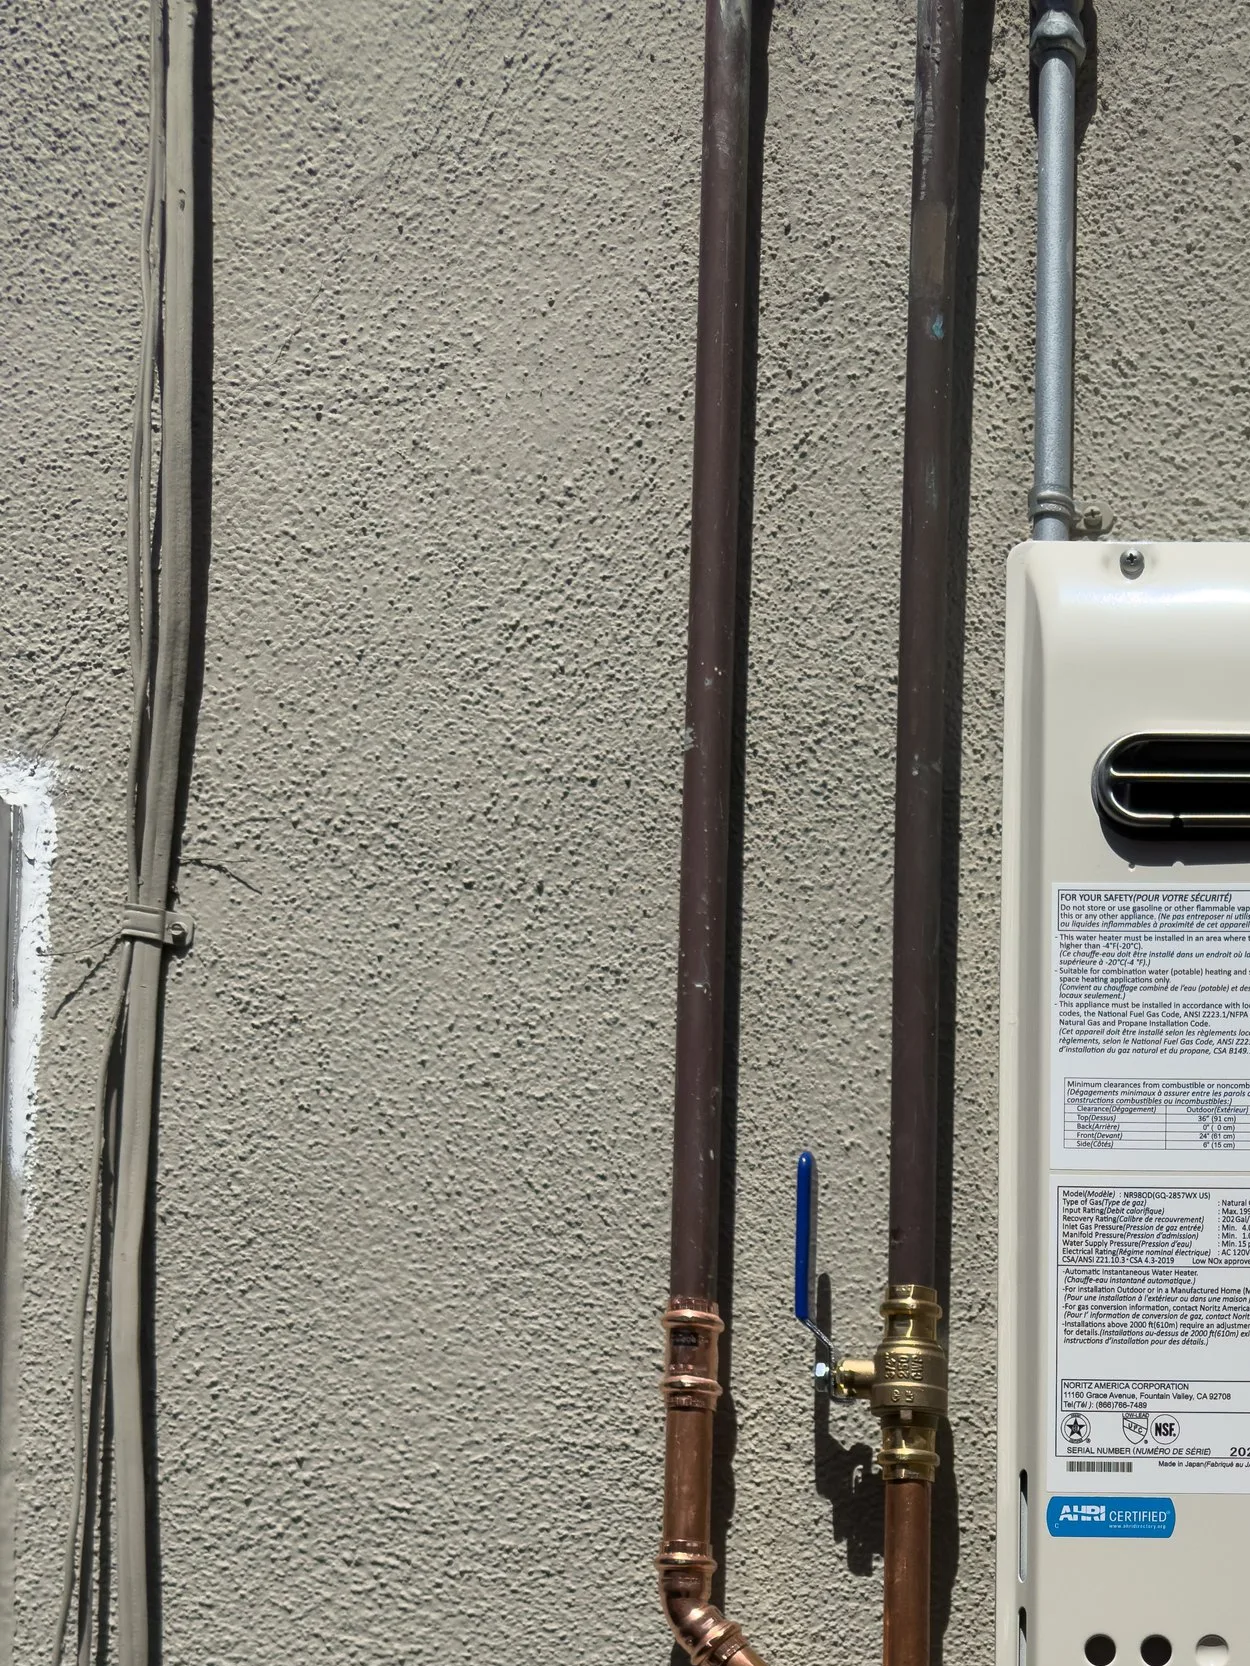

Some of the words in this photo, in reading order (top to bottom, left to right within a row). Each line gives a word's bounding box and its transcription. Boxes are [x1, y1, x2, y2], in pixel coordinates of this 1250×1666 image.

[1060, 893, 1076, 901] FOR
[1078, 893, 1101, 901] YOUR
[1103, 893, 1159, 903] SAFETY(POUR
[1161, 893, 1189, 902] VOTRE
[1190, 892, 1232, 903] SÉCURITÉ)
[1059, 941, 1082, 950] higher
[1117, 1019, 1147, 1027] Propane
[1149, 1019, 1188, 1027] Installation
[1189, 1019, 1210, 1027] Code.
[1103, 1080, 1140, 1088] clearances
[1161, 1081, 1205, 1089] combustible
[1075, 1105, 1158, 1114] Clearance(Dégagement)
[1186, 1105, 1250, 1115] Outdoor(Extérieur)
[1075, 1113, 1116, 1123] Top(Dessus)
[1211, 1115, 1222, 1124] (91
[1223, 1115, 1237, 1124] cm)
[1062, 1190, 1115, 1200] Model(Modèle)
[897, 1354, 909, 1379] 250
[1063, 1381, 1092, 1389] NORITZ
[1131, 1382, 1189, 1390] CORPORATION
[1085, 1391, 1107, 1399] Grace
[1108, 1391, 1137, 1399] Avenue,
[1139, 1391, 1170, 1399] Fountain
[1171, 1392, 1194, 1401] Valley,
[1196, 1392, 1207, 1400] CA
[1208, 1392, 1231, 1400] 92708
[1095, 1400, 1147, 1409] (866)766-7489
[1128, 1423, 1143, 1433] UPC
[1066, 1446, 1094, 1454] SERIAL
[1132, 1445, 1170, 1455] (NUMÉRO
[1172, 1447, 1183, 1455] DE
[1185, 1446, 1211, 1455] SÉRIE)
[1184, 1460, 1234, 1468] Japan(Fabriqué
[1059, 1505, 1106, 1521] AHRI
